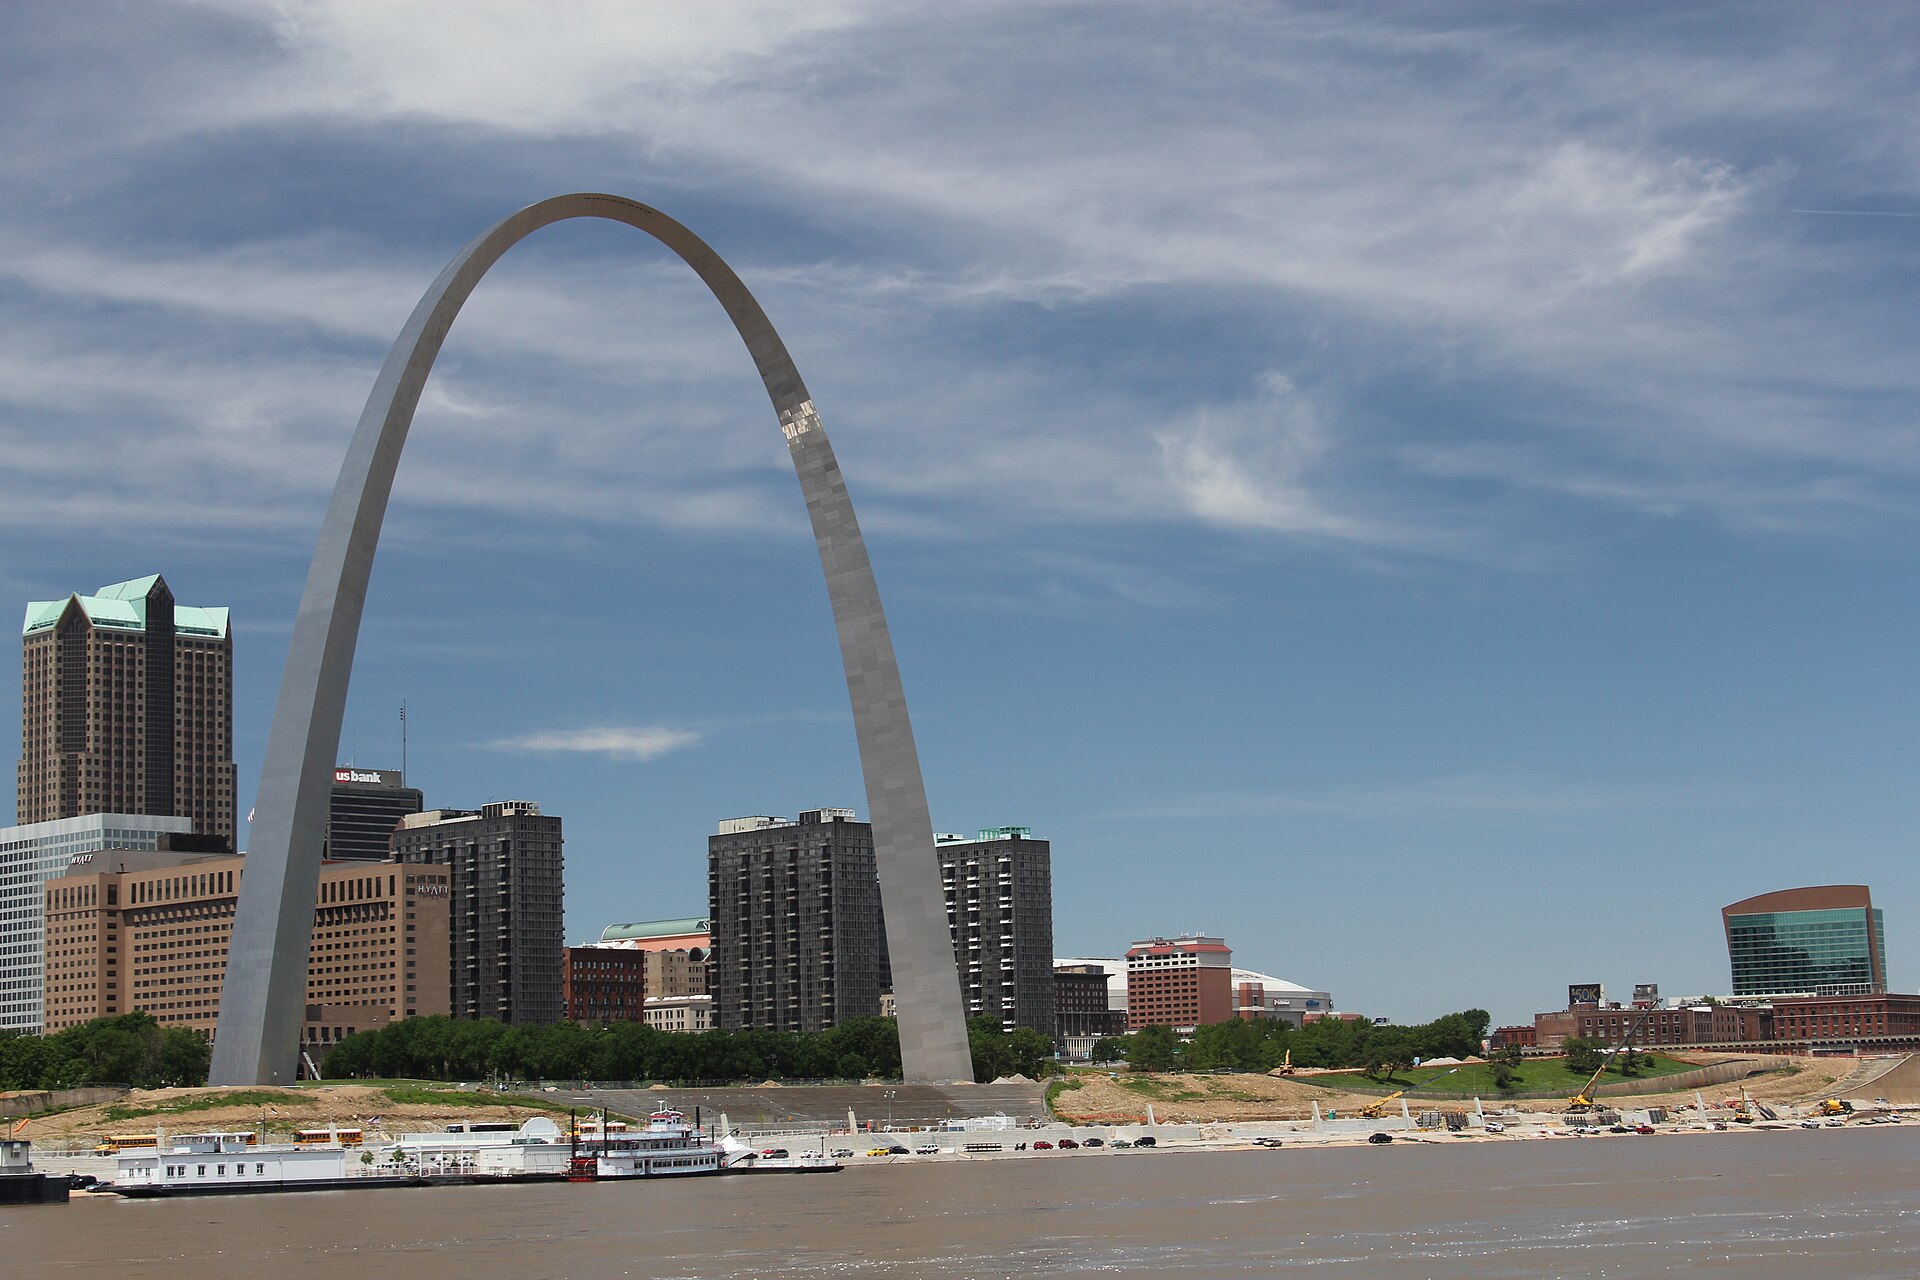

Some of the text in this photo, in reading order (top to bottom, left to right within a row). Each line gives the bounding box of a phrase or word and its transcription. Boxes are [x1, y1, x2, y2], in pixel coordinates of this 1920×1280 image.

[71, 855, 93, 865] HYATT
[418, 885, 449, 895] HYATT
[1571, 987, 1598, 1001] $50K
